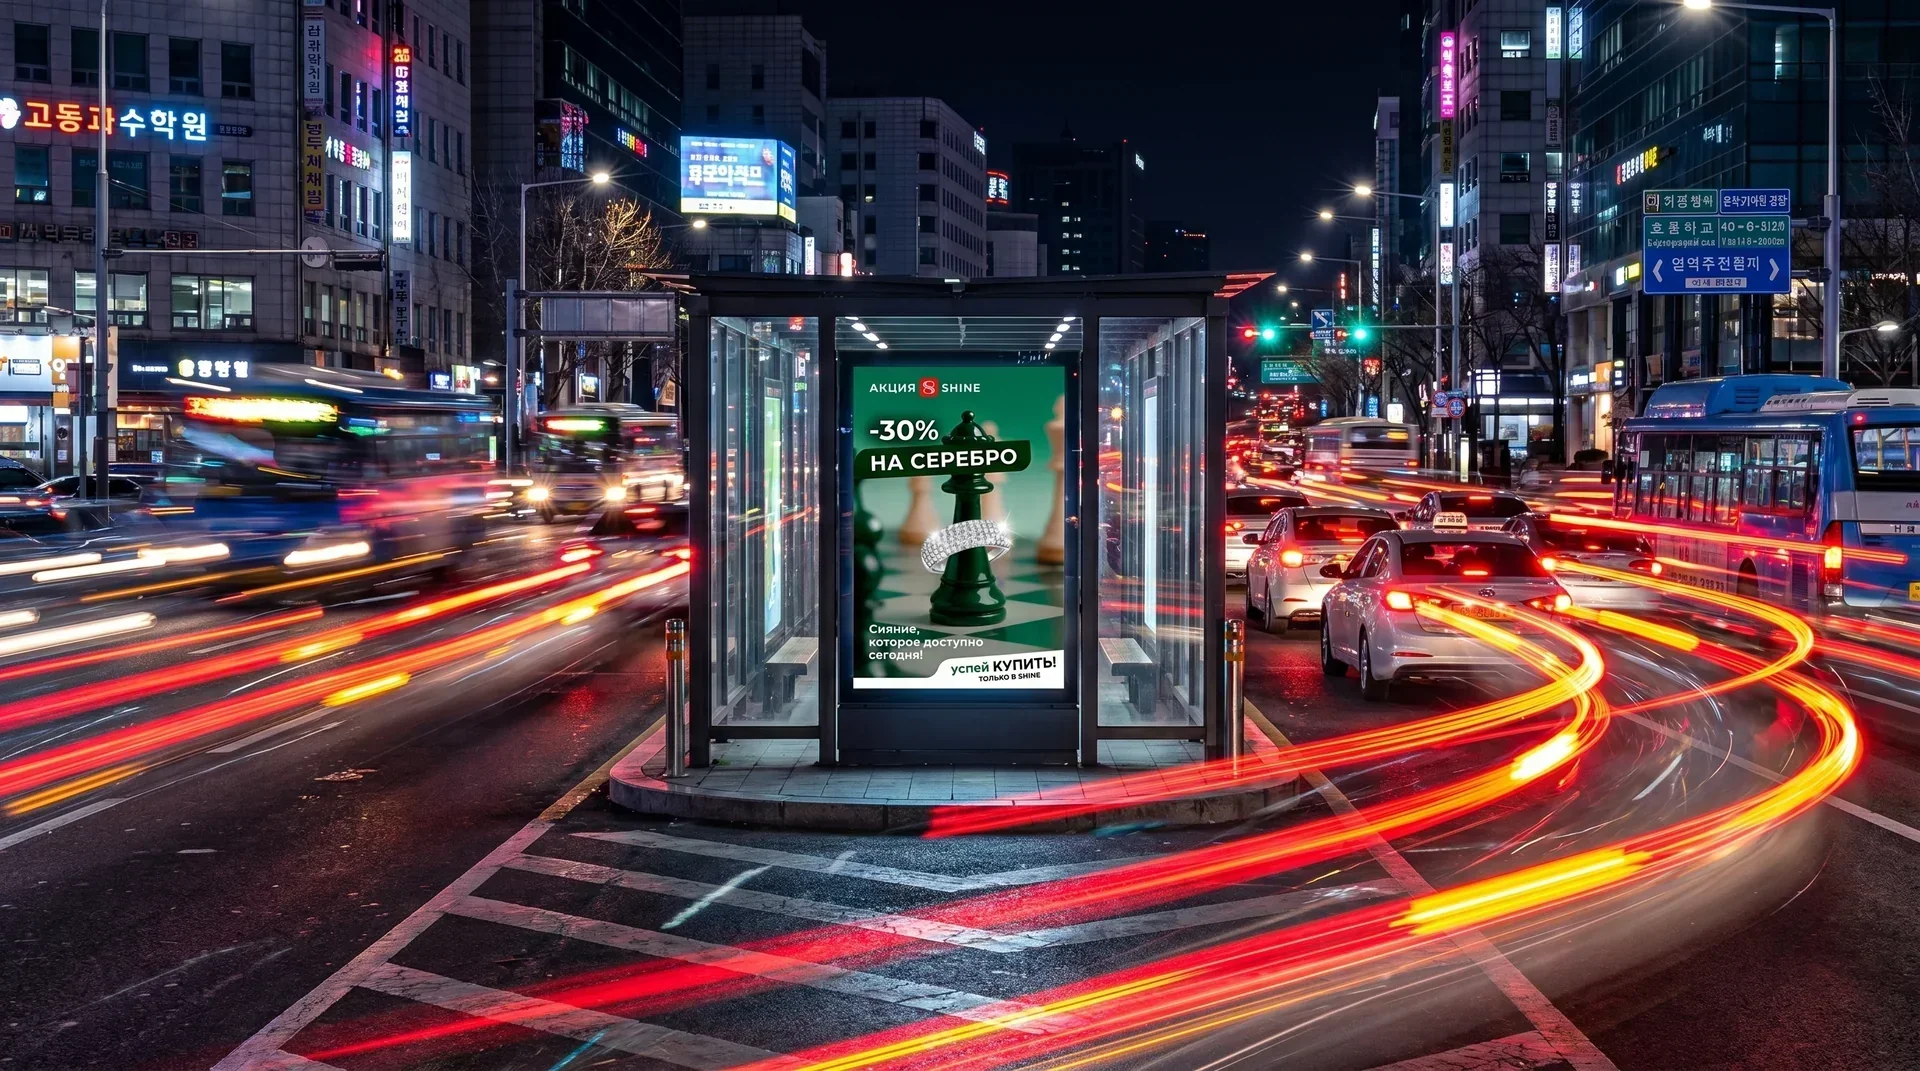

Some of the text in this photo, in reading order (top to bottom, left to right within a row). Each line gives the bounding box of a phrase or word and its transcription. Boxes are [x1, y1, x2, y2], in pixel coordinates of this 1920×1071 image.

[869, 383, 916, 394] АКЦИЯ
[941, 383, 981, 393] SHINE
[869, 419, 939, 441] -30%
[870, 448, 1018, 472] НА СЕРЕБРО
[869, 624, 920, 636] Сияние,
[869, 638, 984, 649] которое доступно
[868, 650, 923, 661] сегодня!
[951, 656, 1057, 676] успей КУПИТЬ!
[979, 674, 1009, 682] ТОЛЬКО
[1018, 672, 1041, 680] SHINE
